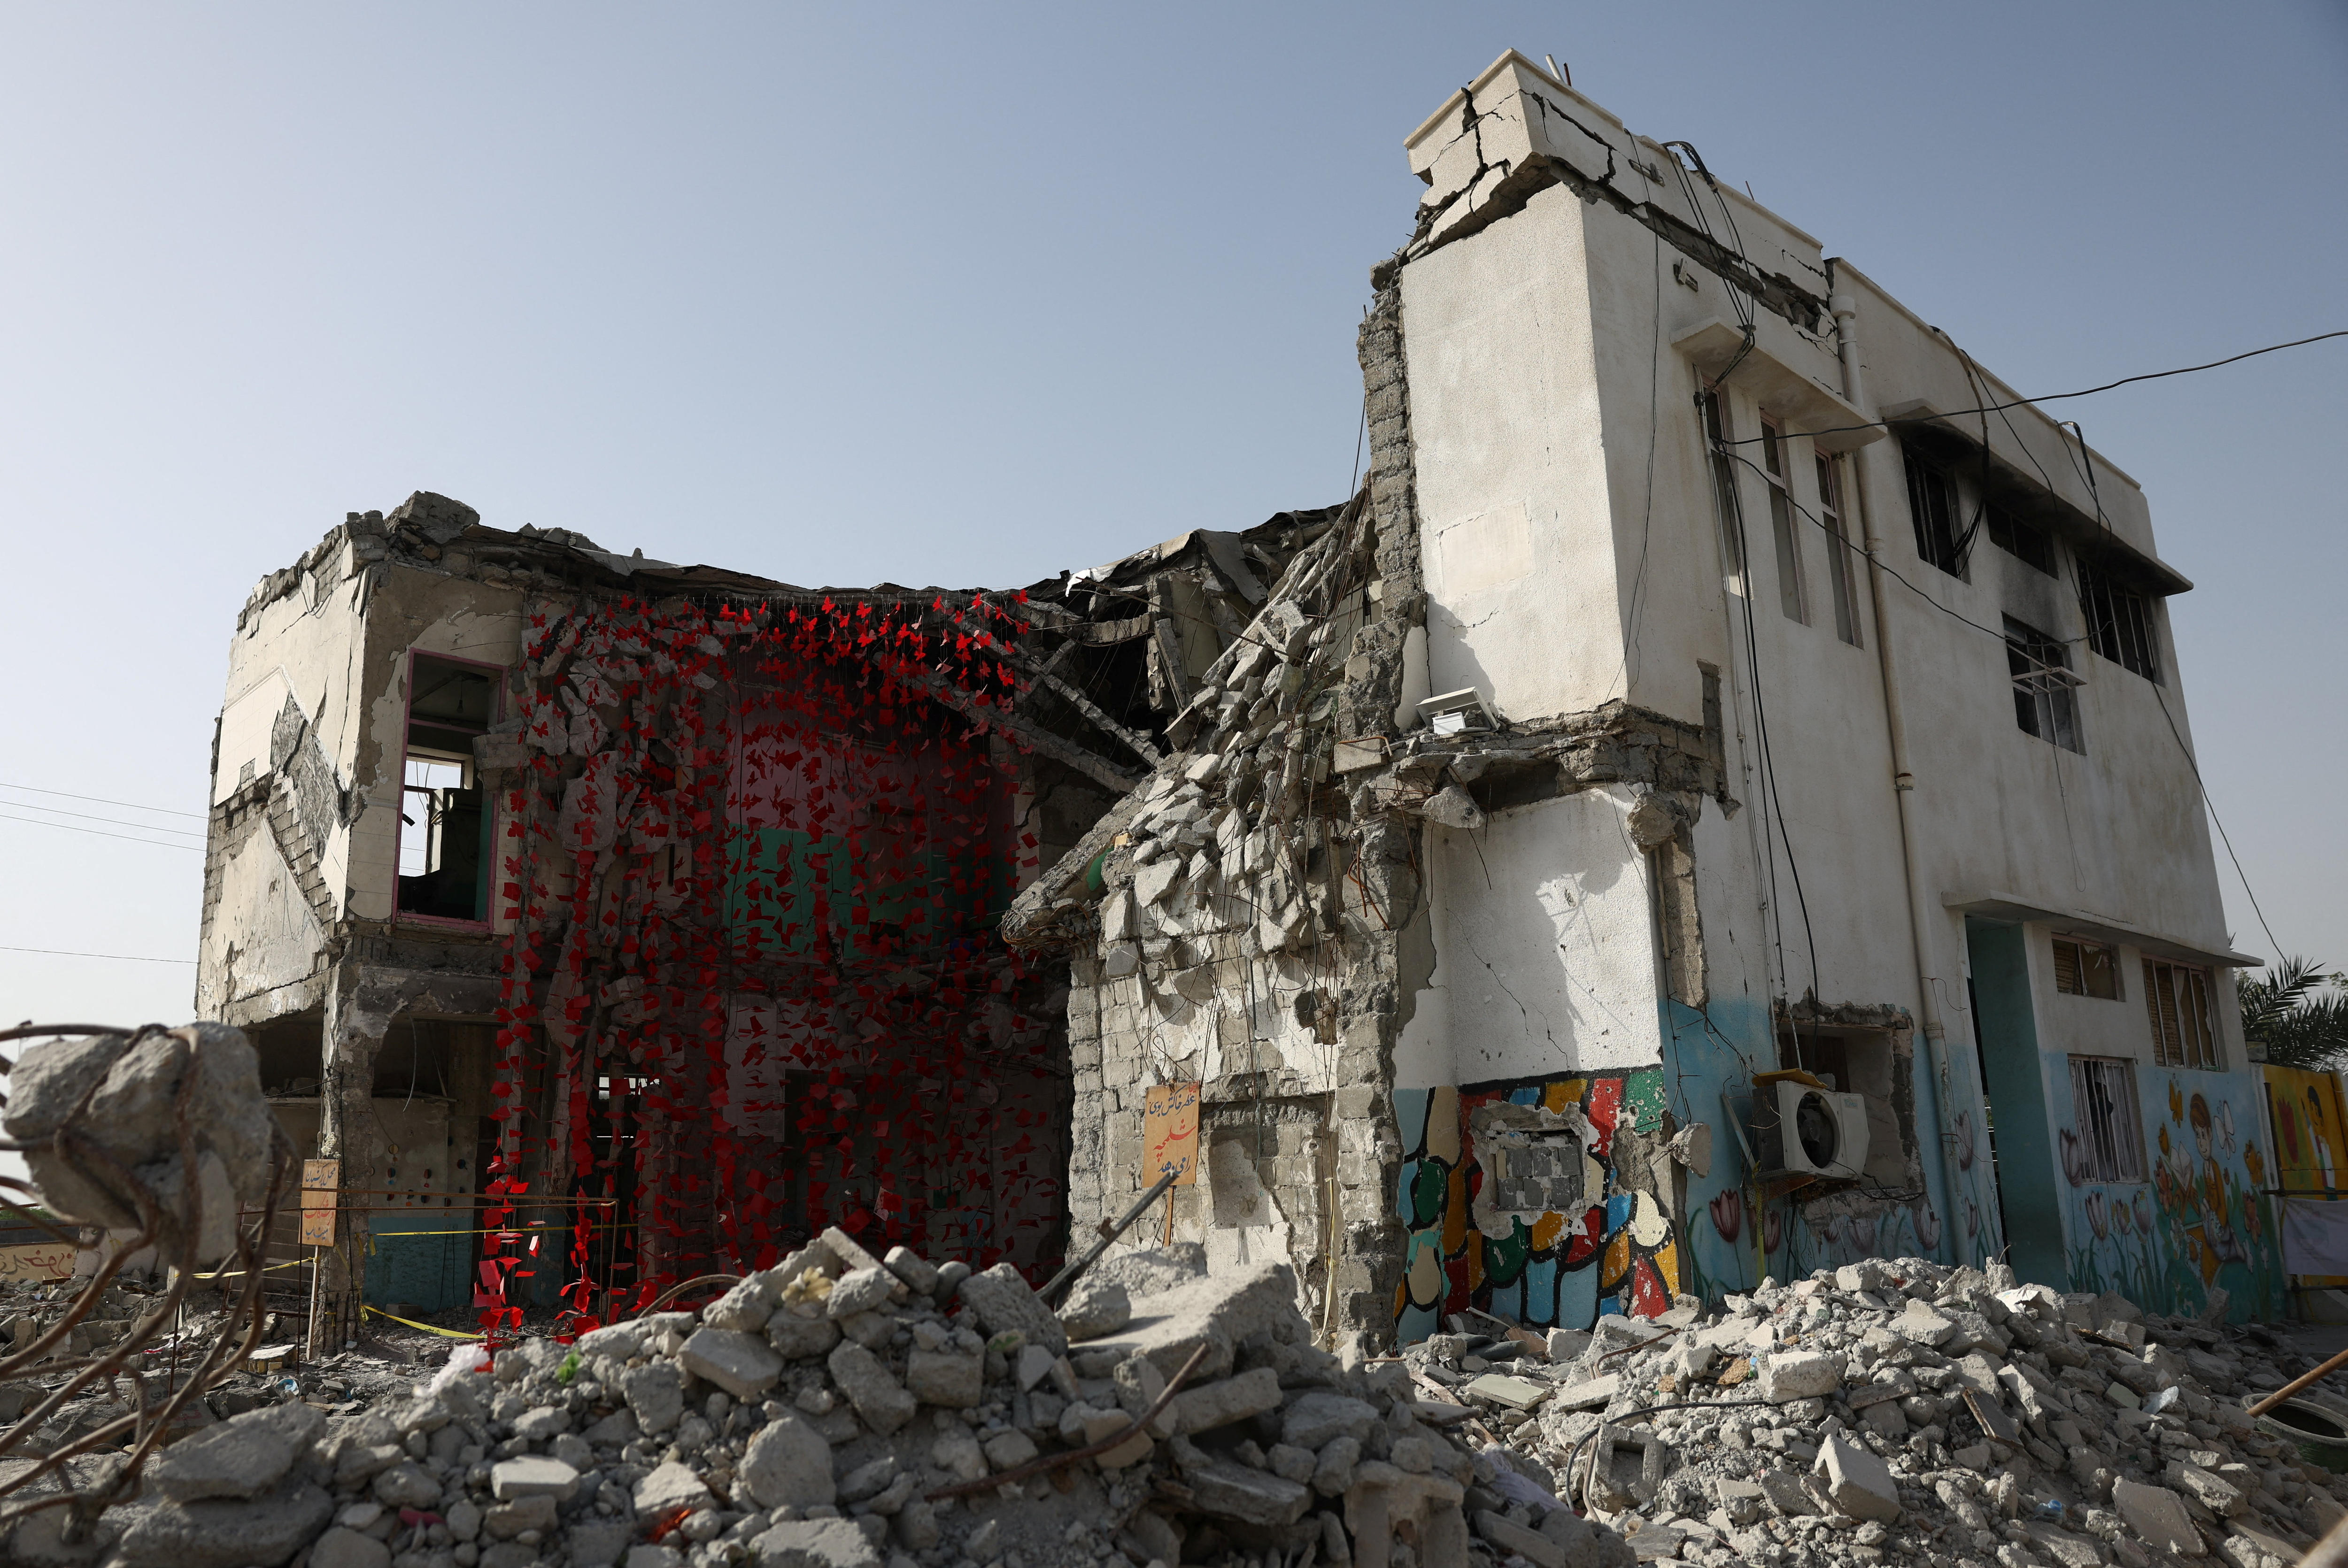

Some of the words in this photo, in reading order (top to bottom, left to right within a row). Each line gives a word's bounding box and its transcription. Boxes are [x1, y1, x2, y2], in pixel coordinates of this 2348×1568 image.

[1150, 1100, 1162, 1117] بوی
[1162, 1085, 1186, 1116] خاکش
[1175, 1094, 1196, 1115] عطر
[1153, 1119, 1197, 1162] شلمچه
[1184, 1155, 1190, 1173] را
[323, 1167, 335, 1186] محل
[306, 1225, 328, 1240] میناب
